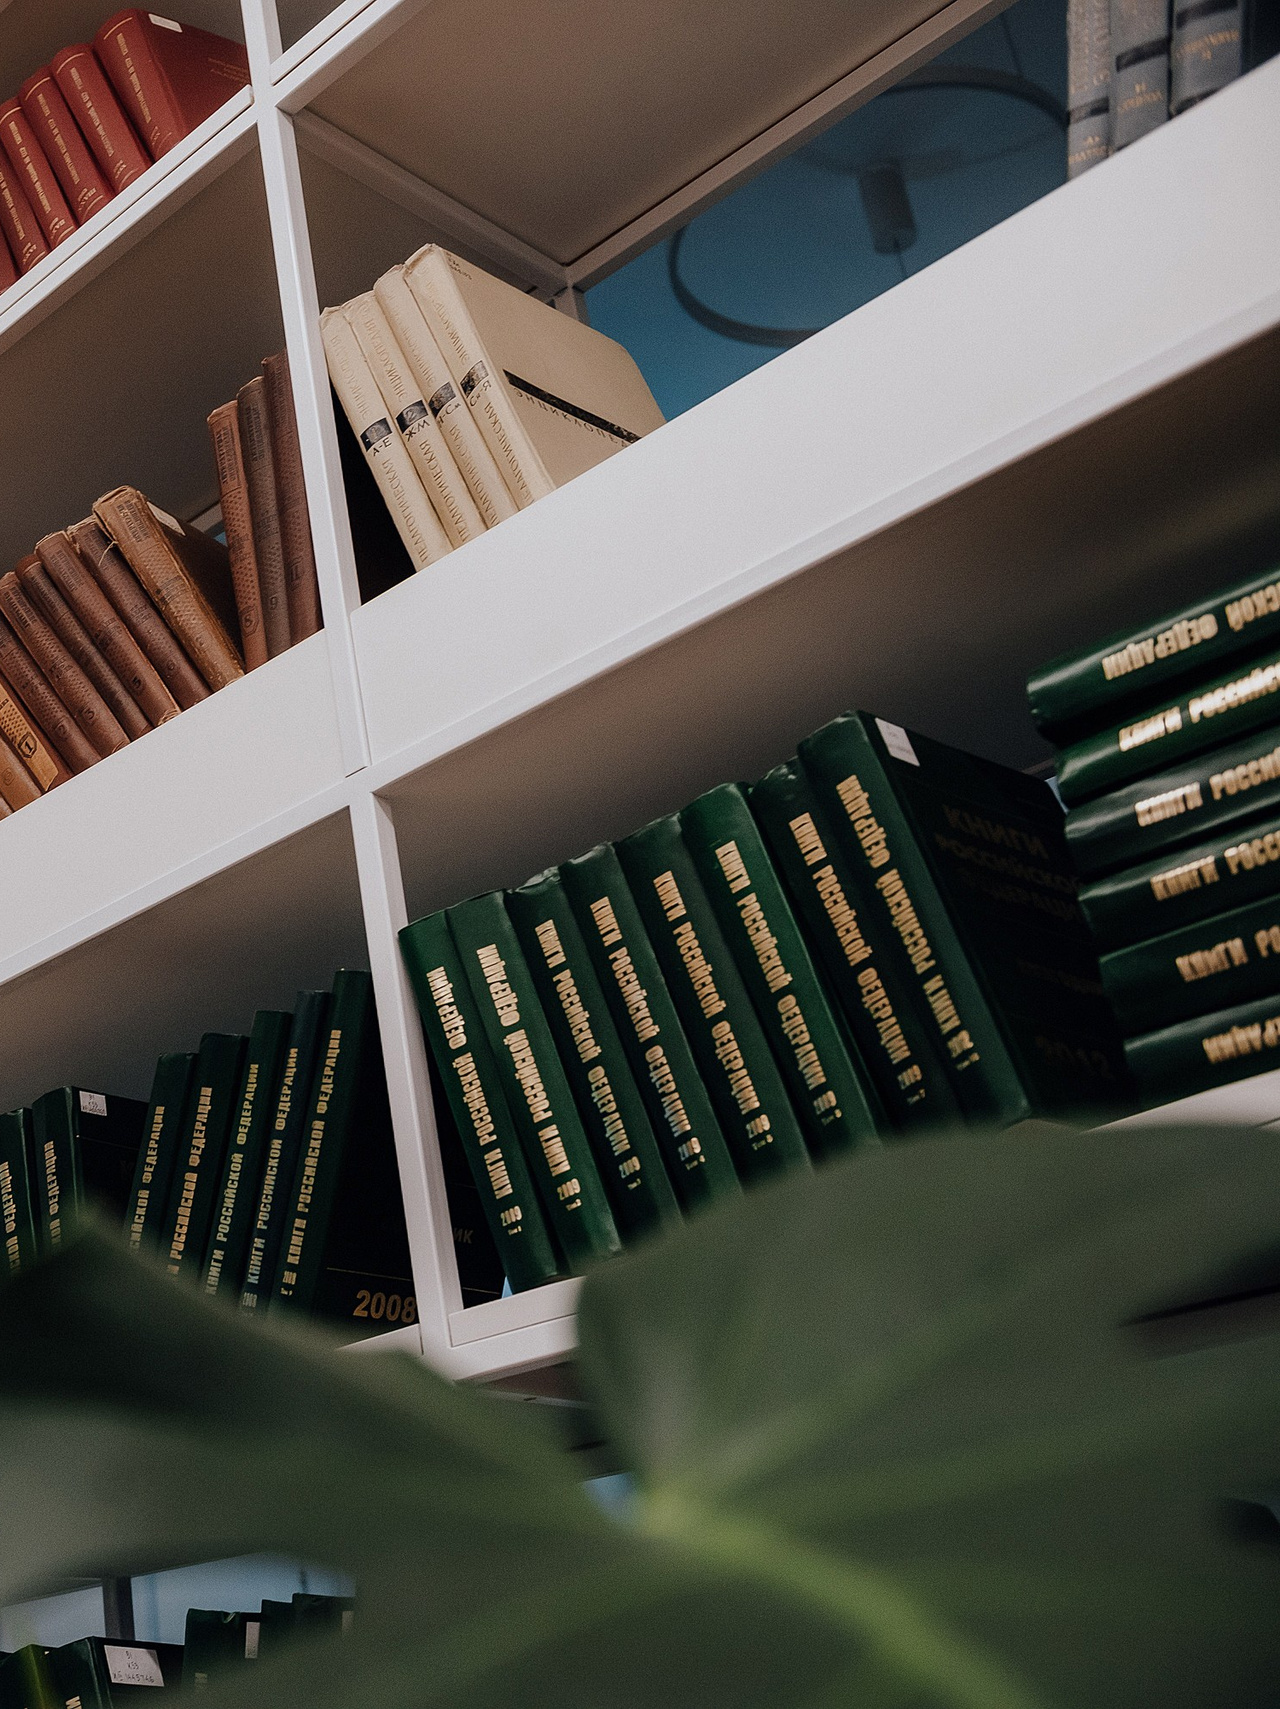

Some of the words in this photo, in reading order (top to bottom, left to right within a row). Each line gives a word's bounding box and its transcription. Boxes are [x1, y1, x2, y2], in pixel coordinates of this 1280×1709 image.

[378, 457, 433, 563] ПЕДАГОГИЧЕСКАЯ
[416, 438, 473, 543] ПЕДАГОГИЧЕСКАЯ
[1104, 613, 1218, 681] ФЕДЕРАЦИИ
[24, 742, 33, 753] 1
[85, 707, 95, 721] 3
[1119, 708, 1182, 751] КНИГИ
[836, 775, 890, 868] ФЕДЕРАЦИИ
[1134, 781, 1204, 827] КНИГИ
[1150, 854, 1219, 900] КНИГИ
[789, 813, 827, 865] КНИГИ
[813, 865, 872, 966] РОССИЙСКОЙ
[858, 968, 910, 1064] ФЕДЕРАЦИИ
[876, 869, 935, 974] РОССИЙСКОЙ
[1175, 937, 1249, 982] КНИГИ
[477, 944, 520, 1026] ФЕДЕРАЦИИ
[653, 871, 686, 921] КНИГИ
[673, 922, 726, 1018] РОССИЙСКОЙ
[712, 1021, 760, 1114] ФЕДЕРАЦИИ
[715, 840, 751, 893] КНИГИ
[737, 893, 793, 992] РОССИЙСКОЙ
[778, 995, 826, 1089] ФЕДЕРАЦИИ
[923, 975, 960, 1034] КНИГИ
[427, 966, 466, 1049] ФЕДЕРАЦИИ
[535, 919, 566, 968] КНИГИ
[553, 969, 602, 1062] РОССИЙСКОЙ
[588, 1066, 630, 1156] ФЕДЕРАЦИИ
[590, 896, 622, 946] КНИГИ
[609, 947, 660, 1042] РОССИЙСКОЙ
[646, 1045, 691, 1136] ФЕДЕРАЦИИ
[452, 1053, 497, 1145] РОССИЙСКОЙ
[504, 1029, 552, 1122] РОССИЙСКОЙ
[44, 1141, 59, 1215] ФЕДЕРАЦИИ
[142, 1106, 165, 1183] ФЕДЕРАЦИИ
[170, 1173, 197, 1260] РОССИЙСКОЙ
[189, 1087, 212, 1166] ФЕДЕРАЦИИ
[203, 1250, 224, 1296] КНИГИ
[216, 1153, 243, 1241] РОССИЙСКОЙ
[237, 1064, 258, 1145] ФЕДЕРАЦИИ
[247, 1238, 265, 1284] КНИГИ
[257, 1139, 282, 1229] РОССИЙСКОЙ
[275, 1048, 298, 1130] ФЕДЕРАЦИИ
[287, 1218, 306, 1264] КНИГИ
[297, 1120, 325, 1212] РОССИЙСКОЙ
[317, 1030, 341, 1113] ФЕДЕРАЦИИ
[484, 1148, 513, 1199] КНИГИ
[539, 1124, 571, 1176] КНИГИ
[500, 1206, 522, 1226] 2009
[557, 1178, 580, 1200] 2009
[353, 1290, 417, 1323] 2008
